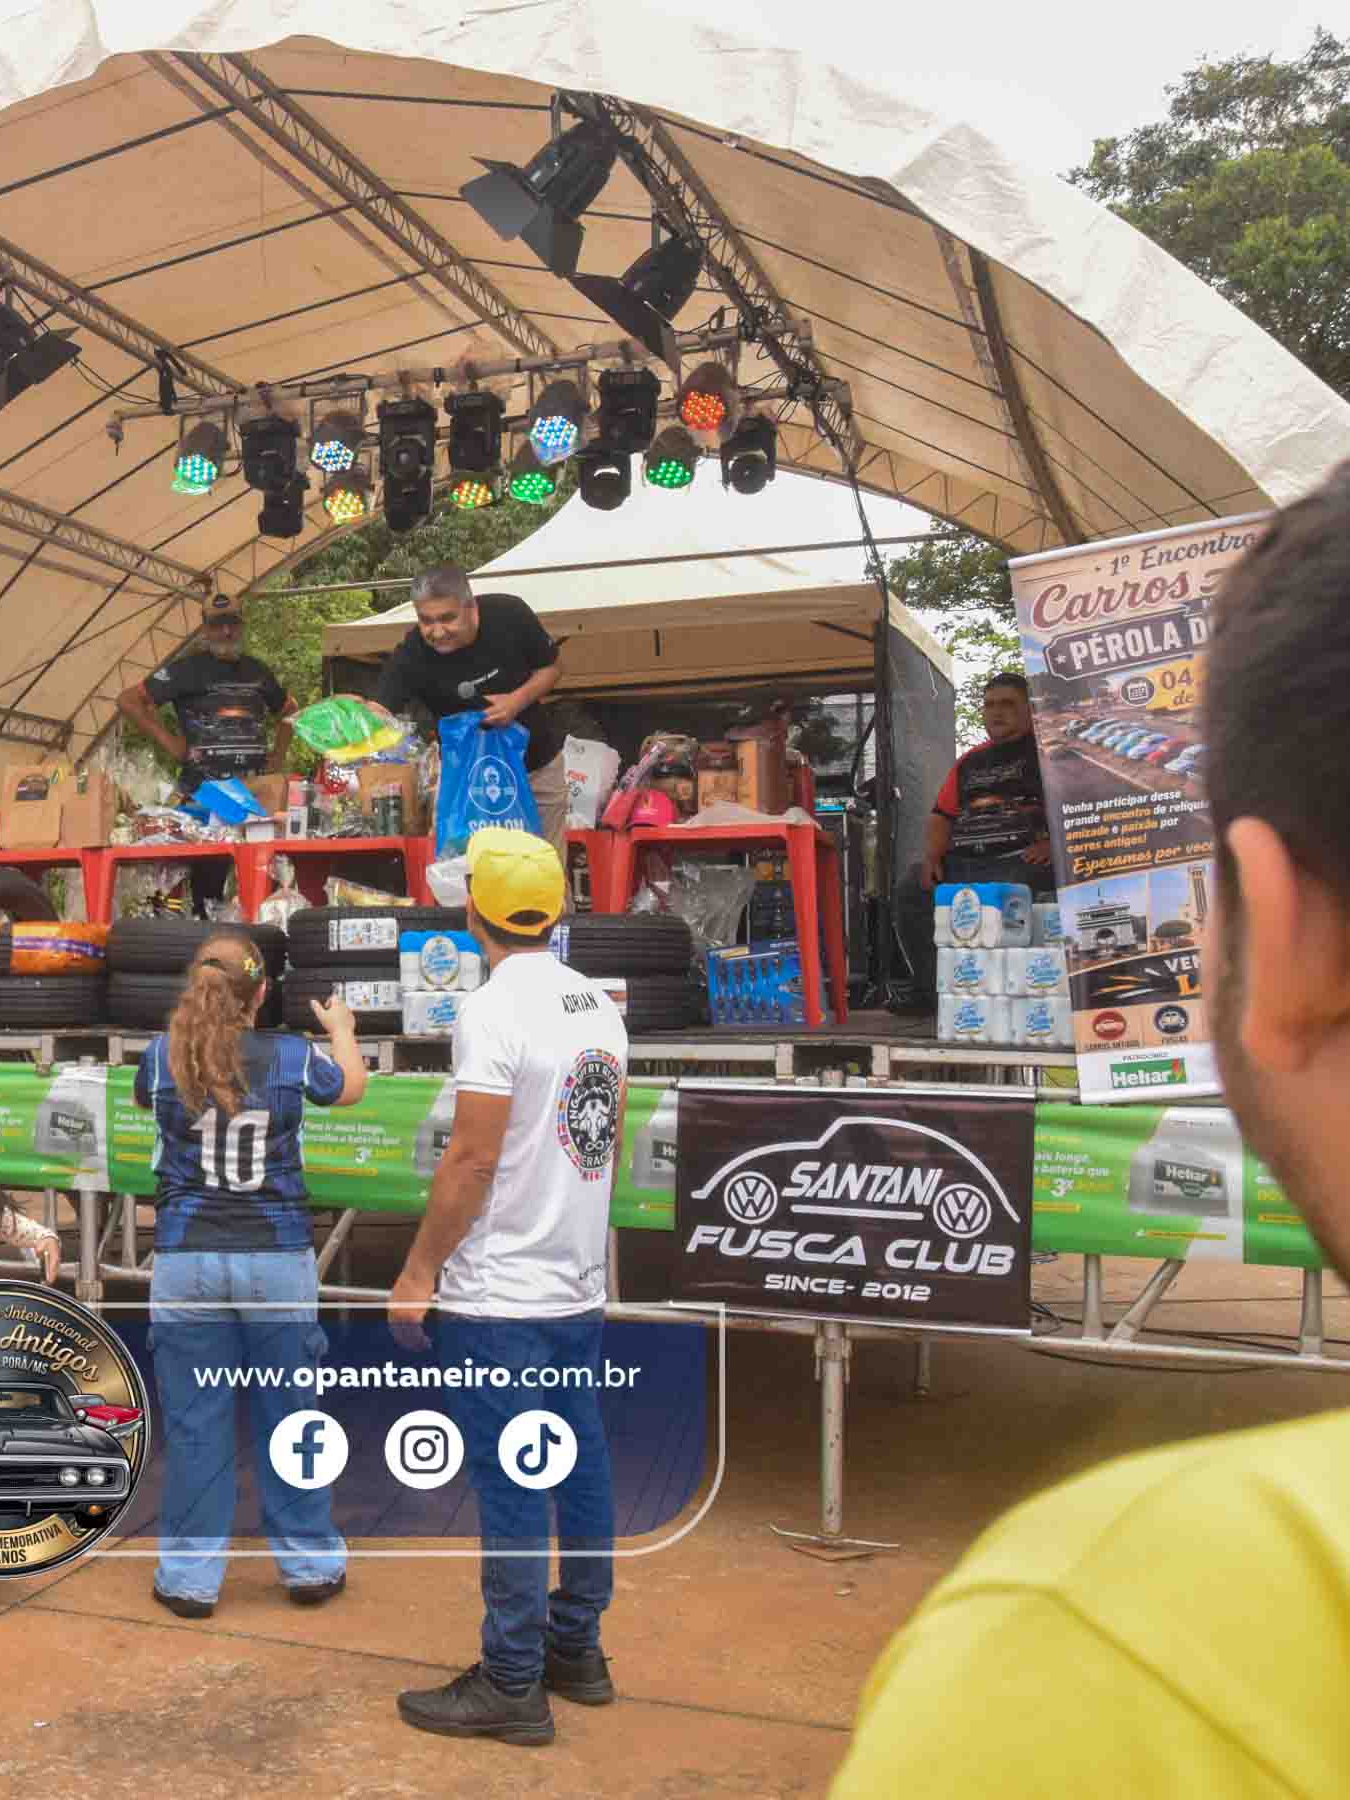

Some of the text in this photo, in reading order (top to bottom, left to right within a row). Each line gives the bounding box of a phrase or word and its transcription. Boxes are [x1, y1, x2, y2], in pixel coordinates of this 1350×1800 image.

[1032, 570, 1190, 630] Carros
[1069, 620, 1184, 671] PÉROLA
[1161, 667, 1193, 690] 04
[1062, 800, 1094, 815] Venha
[1096, 793, 1149, 811] participar
[1063, 813, 1101, 830] grande
[1102, 806, 1151, 822] encontro
[1153, 804, 1167, 816] de
[1111, 825, 1119, 835] e
[1159, 816, 1179, 830] por
[1073, 850, 1152, 877] Esperamos
[1154, 845, 1182, 864] por
[561, 991, 600, 1014] ADRIAN
[189, 1108, 270, 1193] 10
[1034, 1151, 1053, 1161] ais
[781, 1161, 943, 1206] SANTANI
[686, 1224, 1016, 1276] FUSCA CLUB
[861, 1282, 931, 1302] 2012
